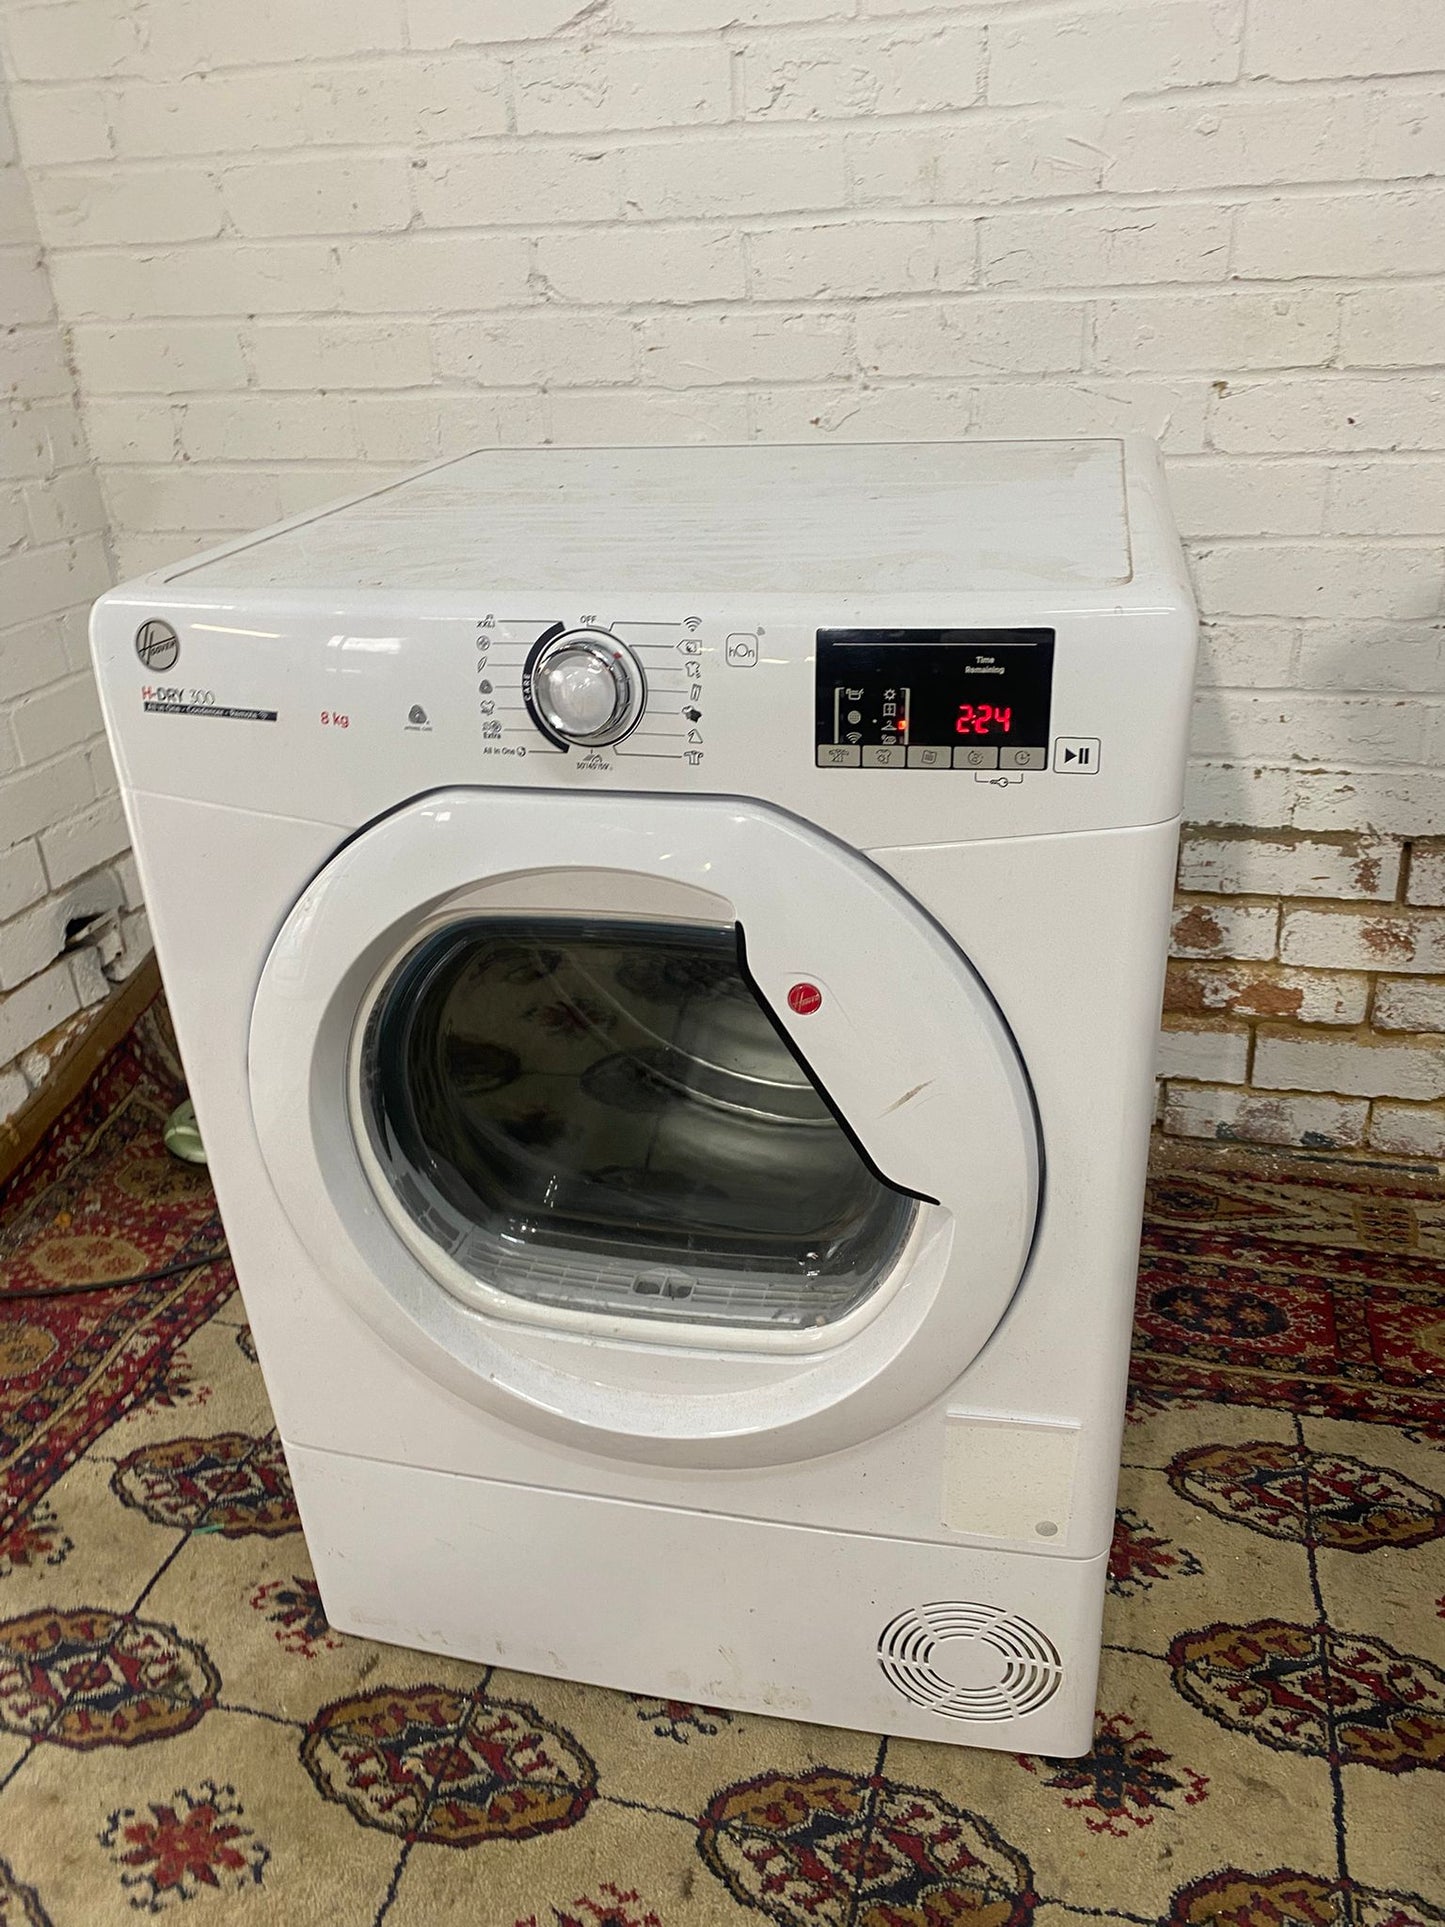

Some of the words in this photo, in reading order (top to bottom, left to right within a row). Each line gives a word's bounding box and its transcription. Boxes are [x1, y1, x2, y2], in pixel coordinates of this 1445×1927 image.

[580, 615, 596, 624] OFF
[729, 647, 755, 660] hOn
[976, 655, 995, 664] Time
[965, 665, 1005, 675] Remaining
[523, 673, 531, 702] CARE
[141, 686, 184, 703] H-DRY
[189, 690, 216, 705] 300
[320, 711, 329, 725] 8
[332, 713, 350, 728] kg
[955, 703, 1013, 734] 2:24
